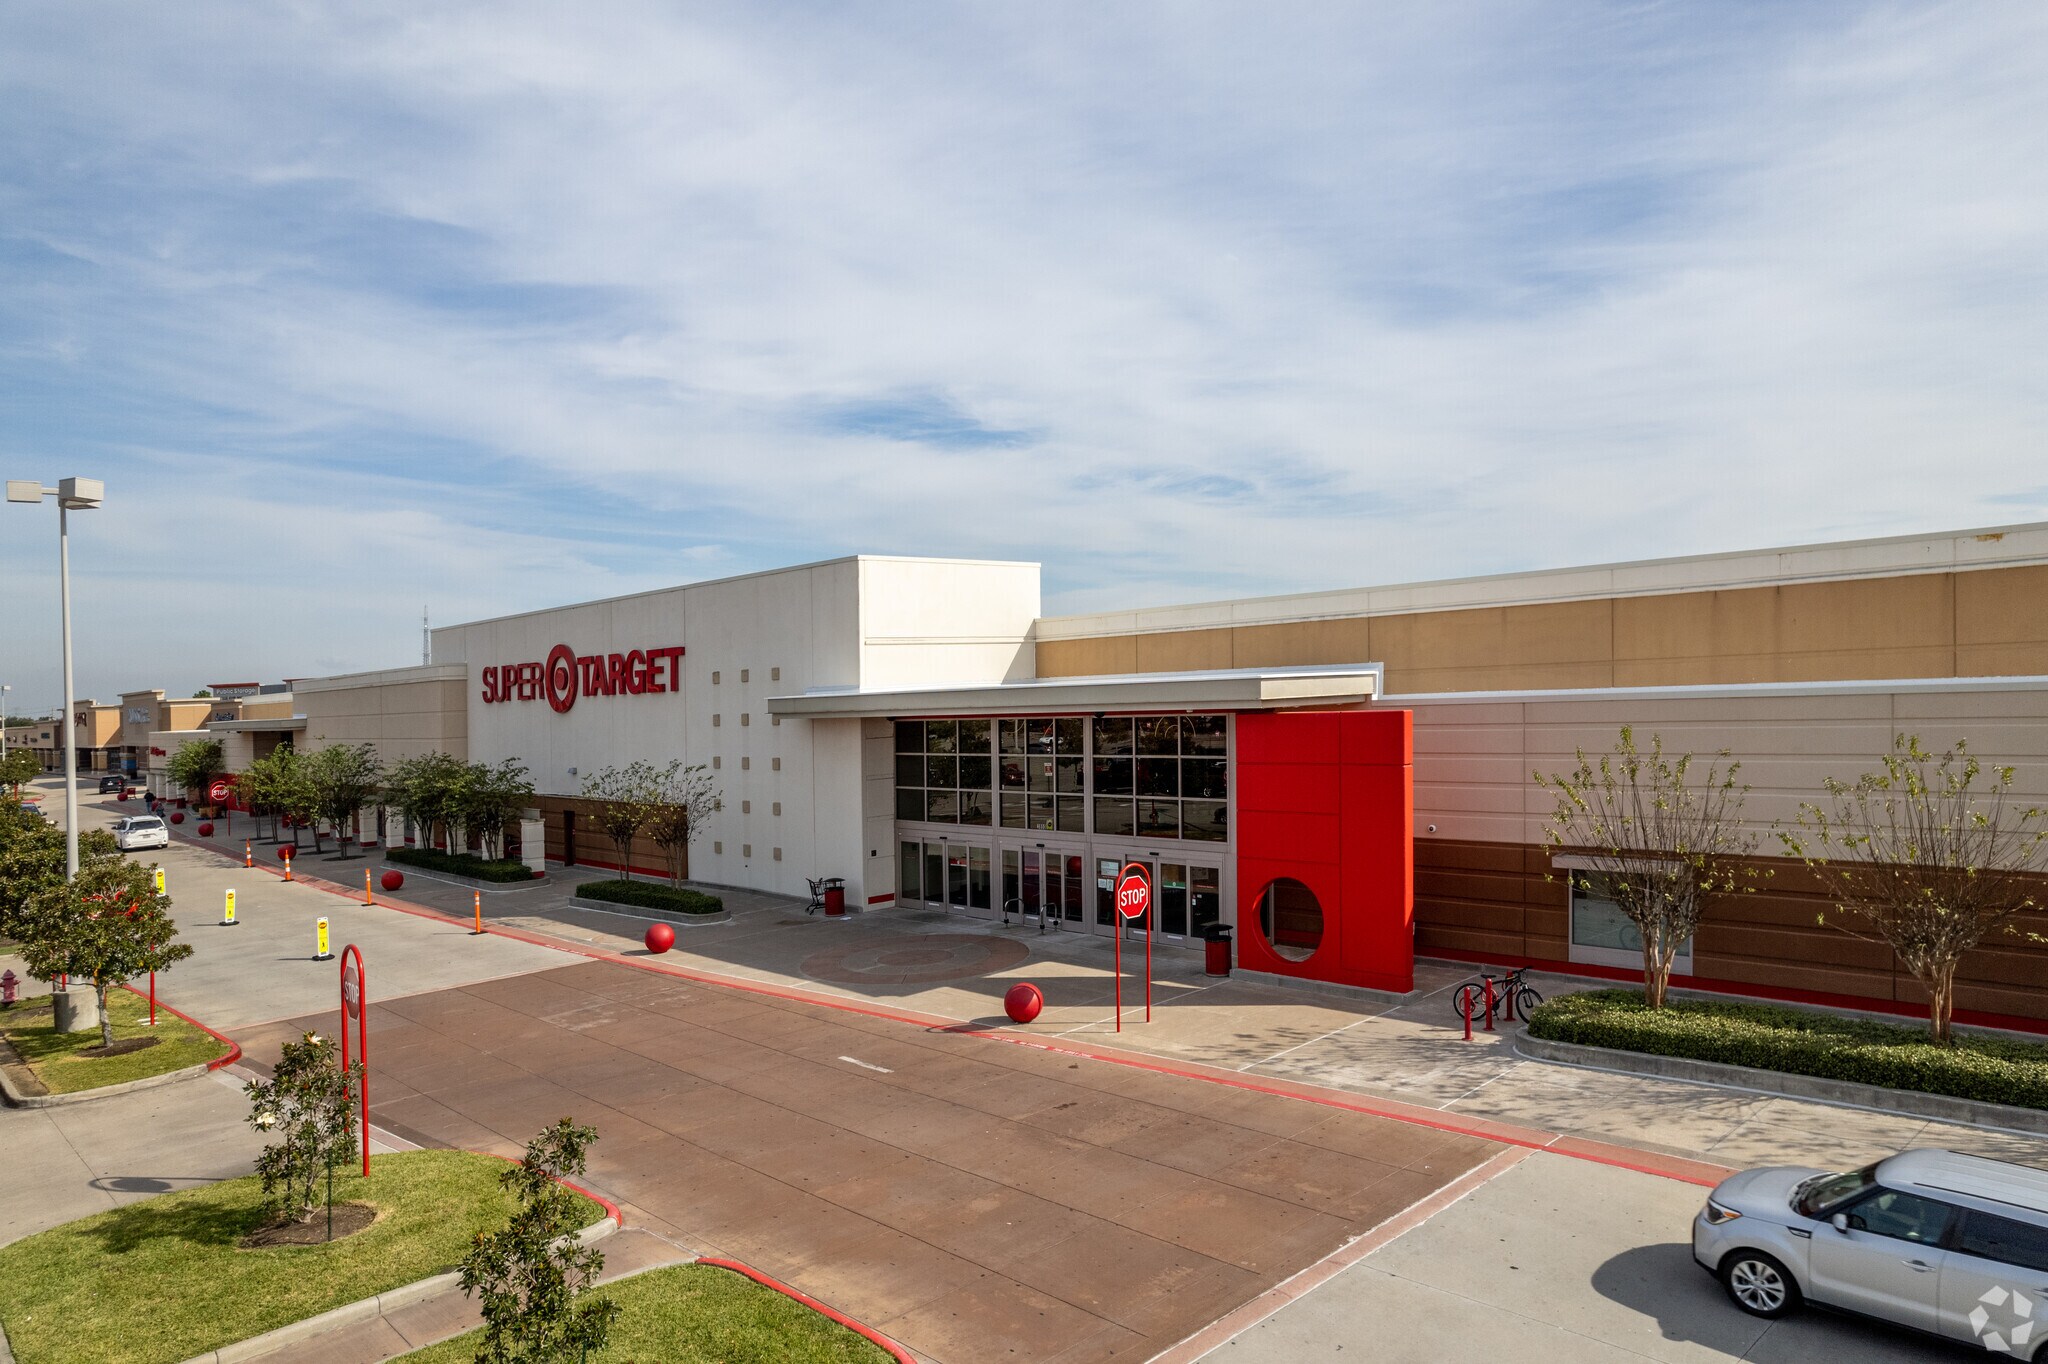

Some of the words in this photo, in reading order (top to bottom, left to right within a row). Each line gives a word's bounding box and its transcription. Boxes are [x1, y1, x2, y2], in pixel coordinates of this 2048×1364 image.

[482, 662, 545, 704] SUPER
[577, 647, 686, 697] TARGET
[1120, 887, 1146, 907] STOP
[344, 981, 359, 1005] STOP
